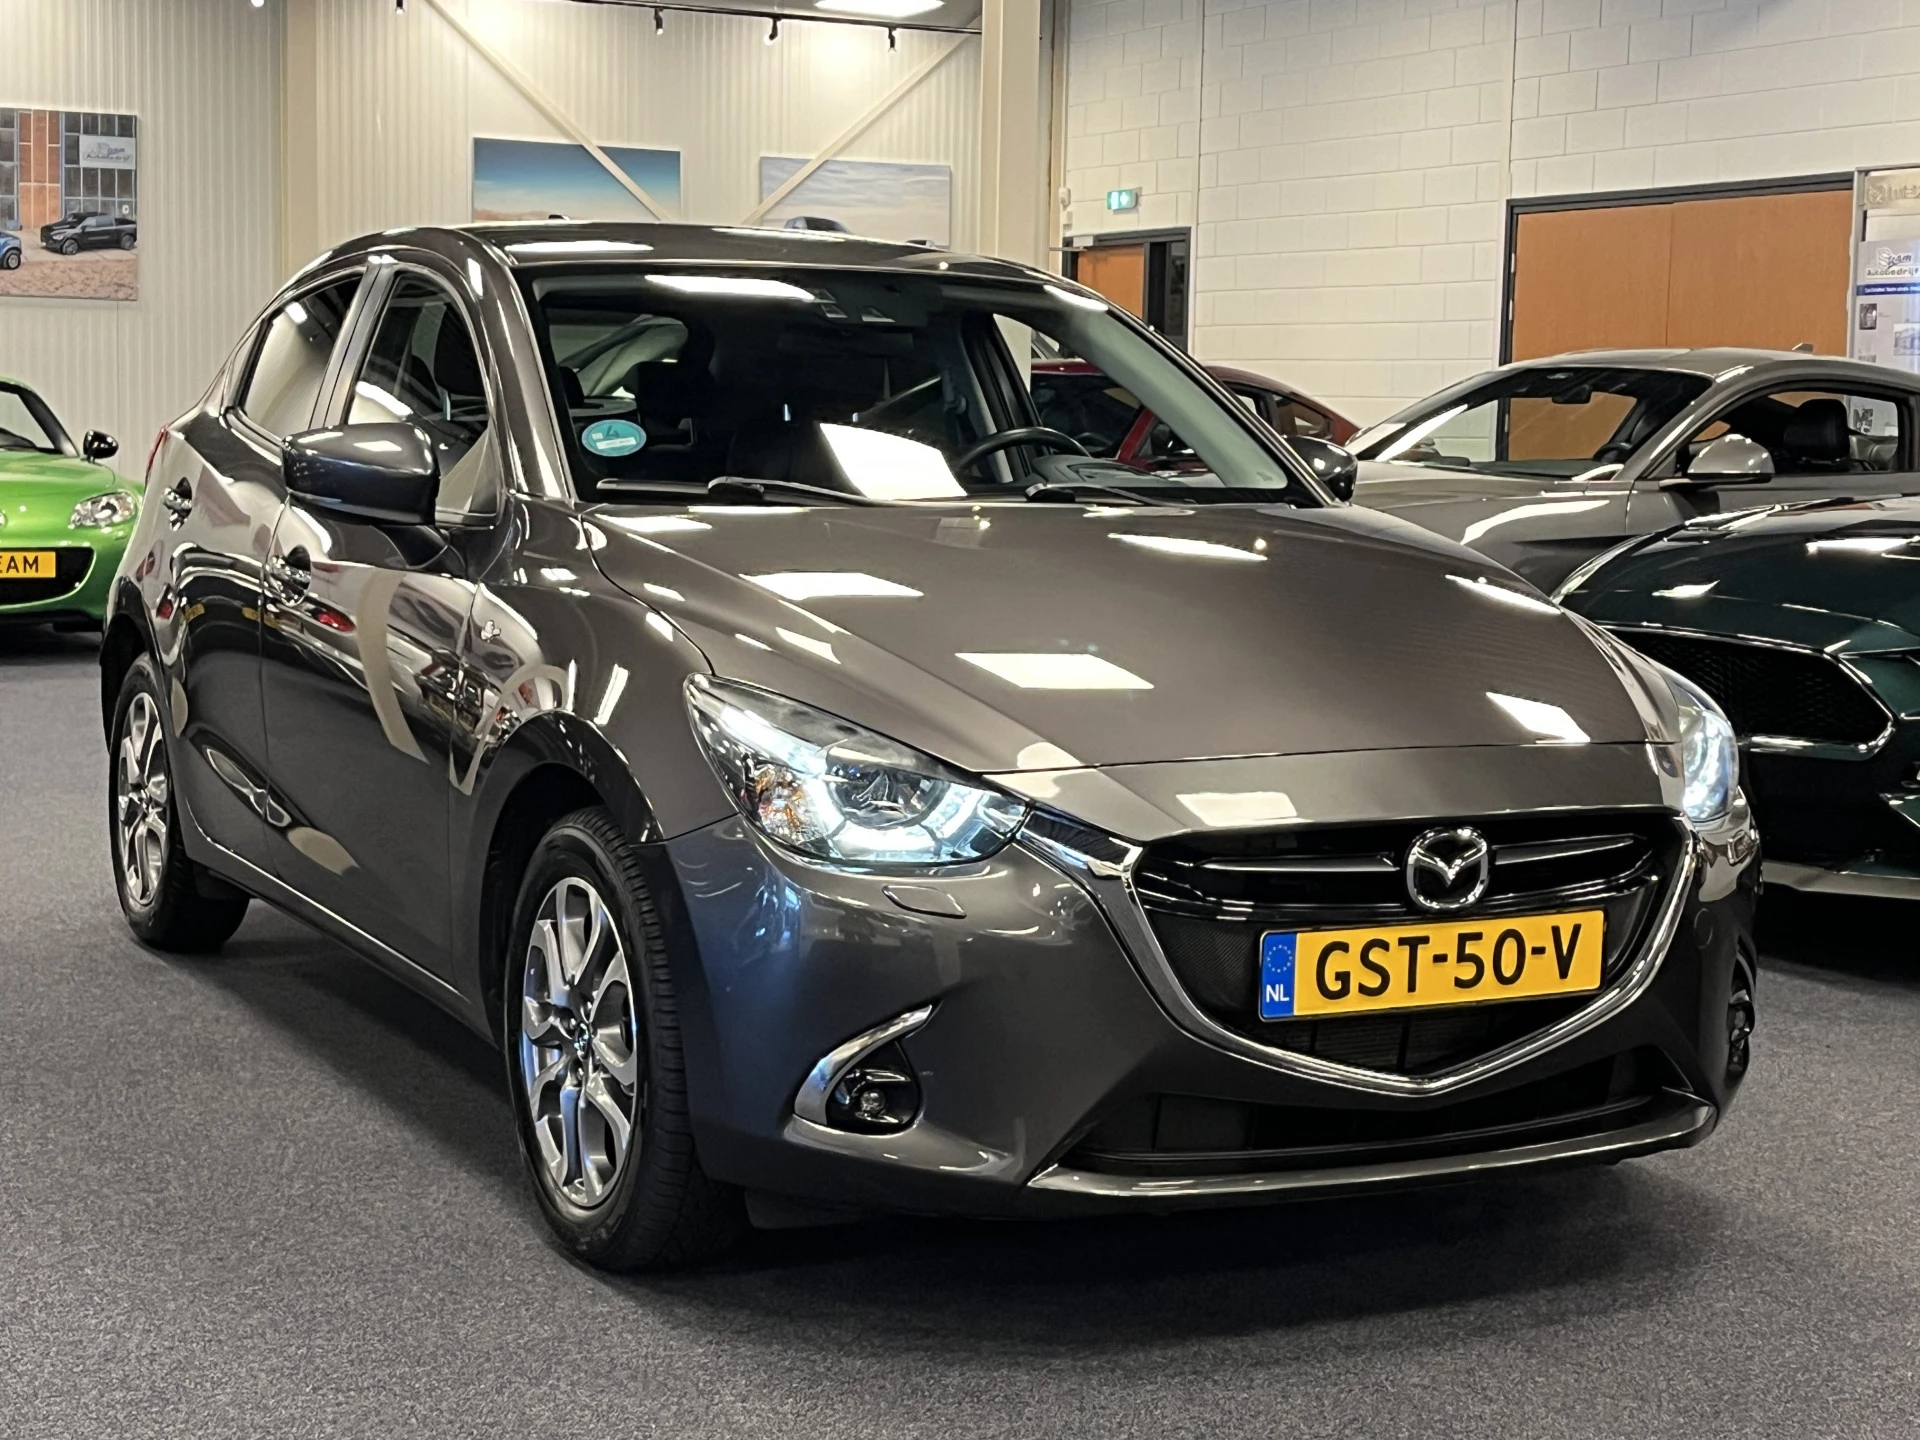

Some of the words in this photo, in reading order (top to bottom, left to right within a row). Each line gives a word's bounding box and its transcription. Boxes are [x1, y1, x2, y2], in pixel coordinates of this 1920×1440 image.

[0, 555, 39, 574] AM
[1315, 923, 1582, 1001] GST-50-V
[1265, 983, 1290, 1003] NL
